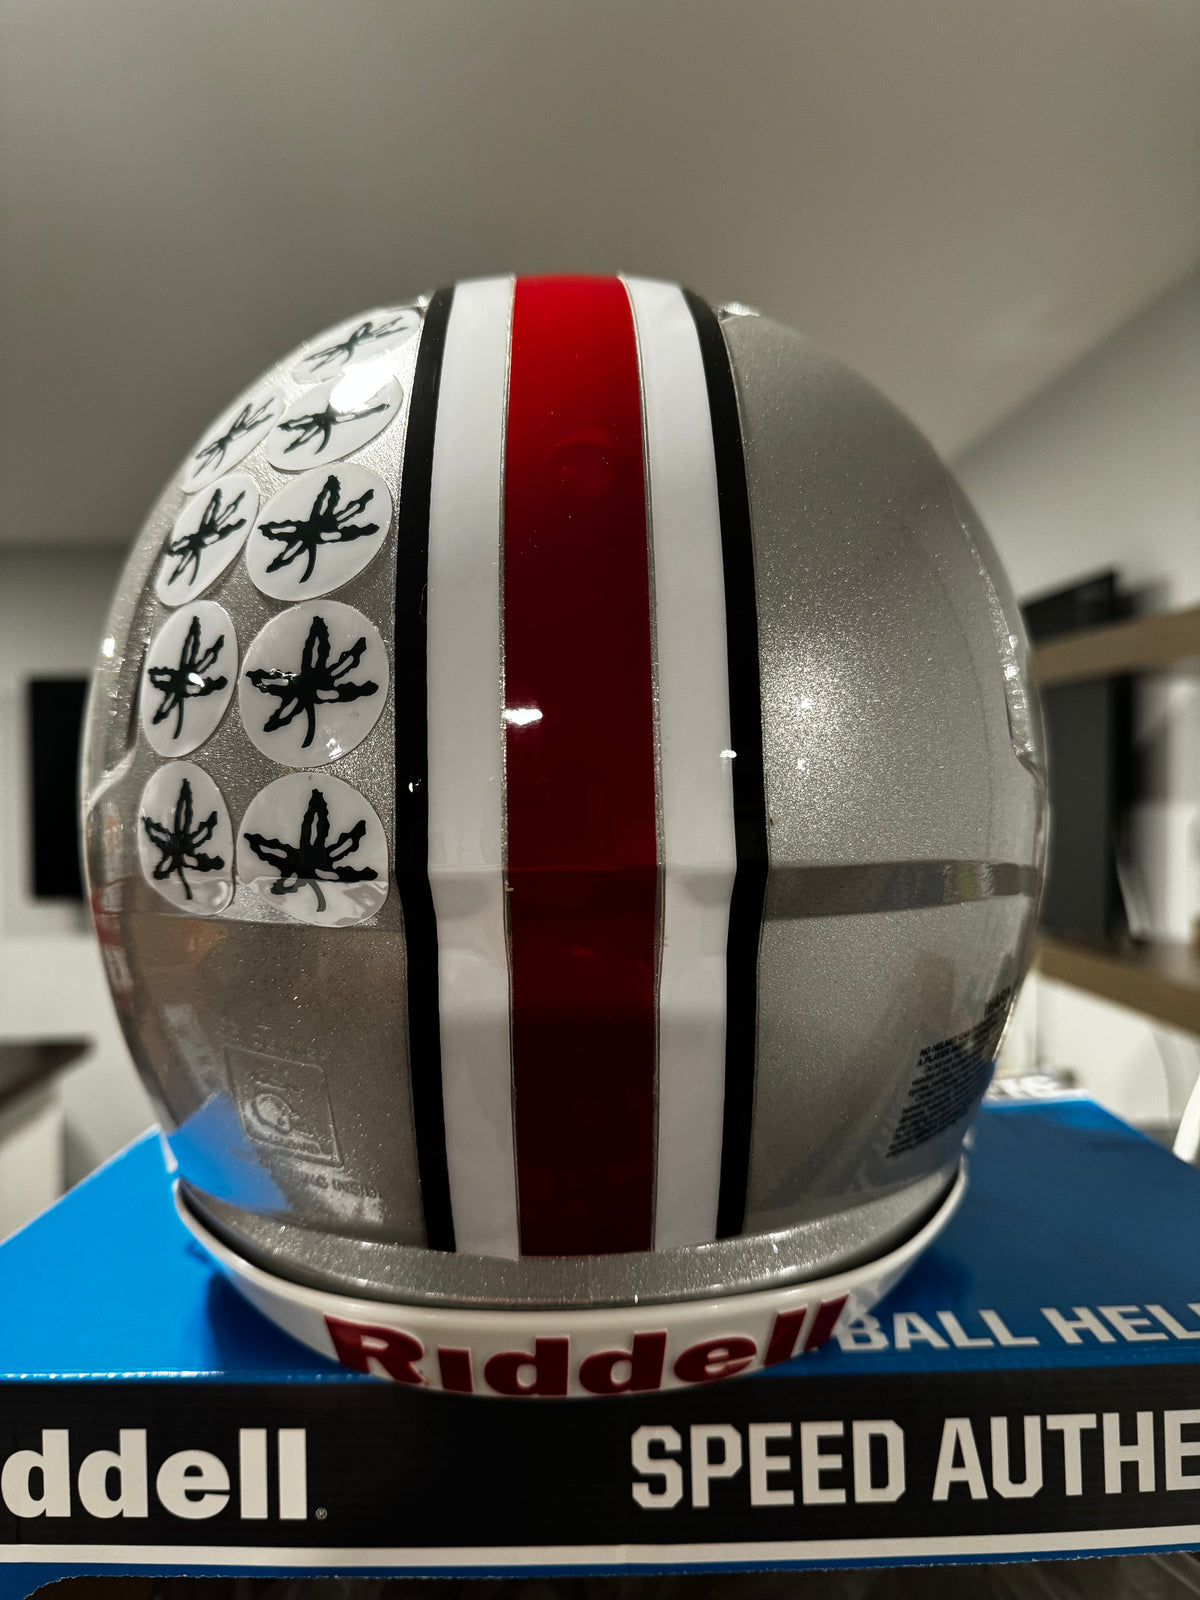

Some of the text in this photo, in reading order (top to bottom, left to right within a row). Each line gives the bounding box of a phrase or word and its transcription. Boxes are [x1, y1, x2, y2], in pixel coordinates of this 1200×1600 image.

[324, 1293, 849, 1396] Riddell
[631, 1409, 1200, 1508] SPEED AUTHE
